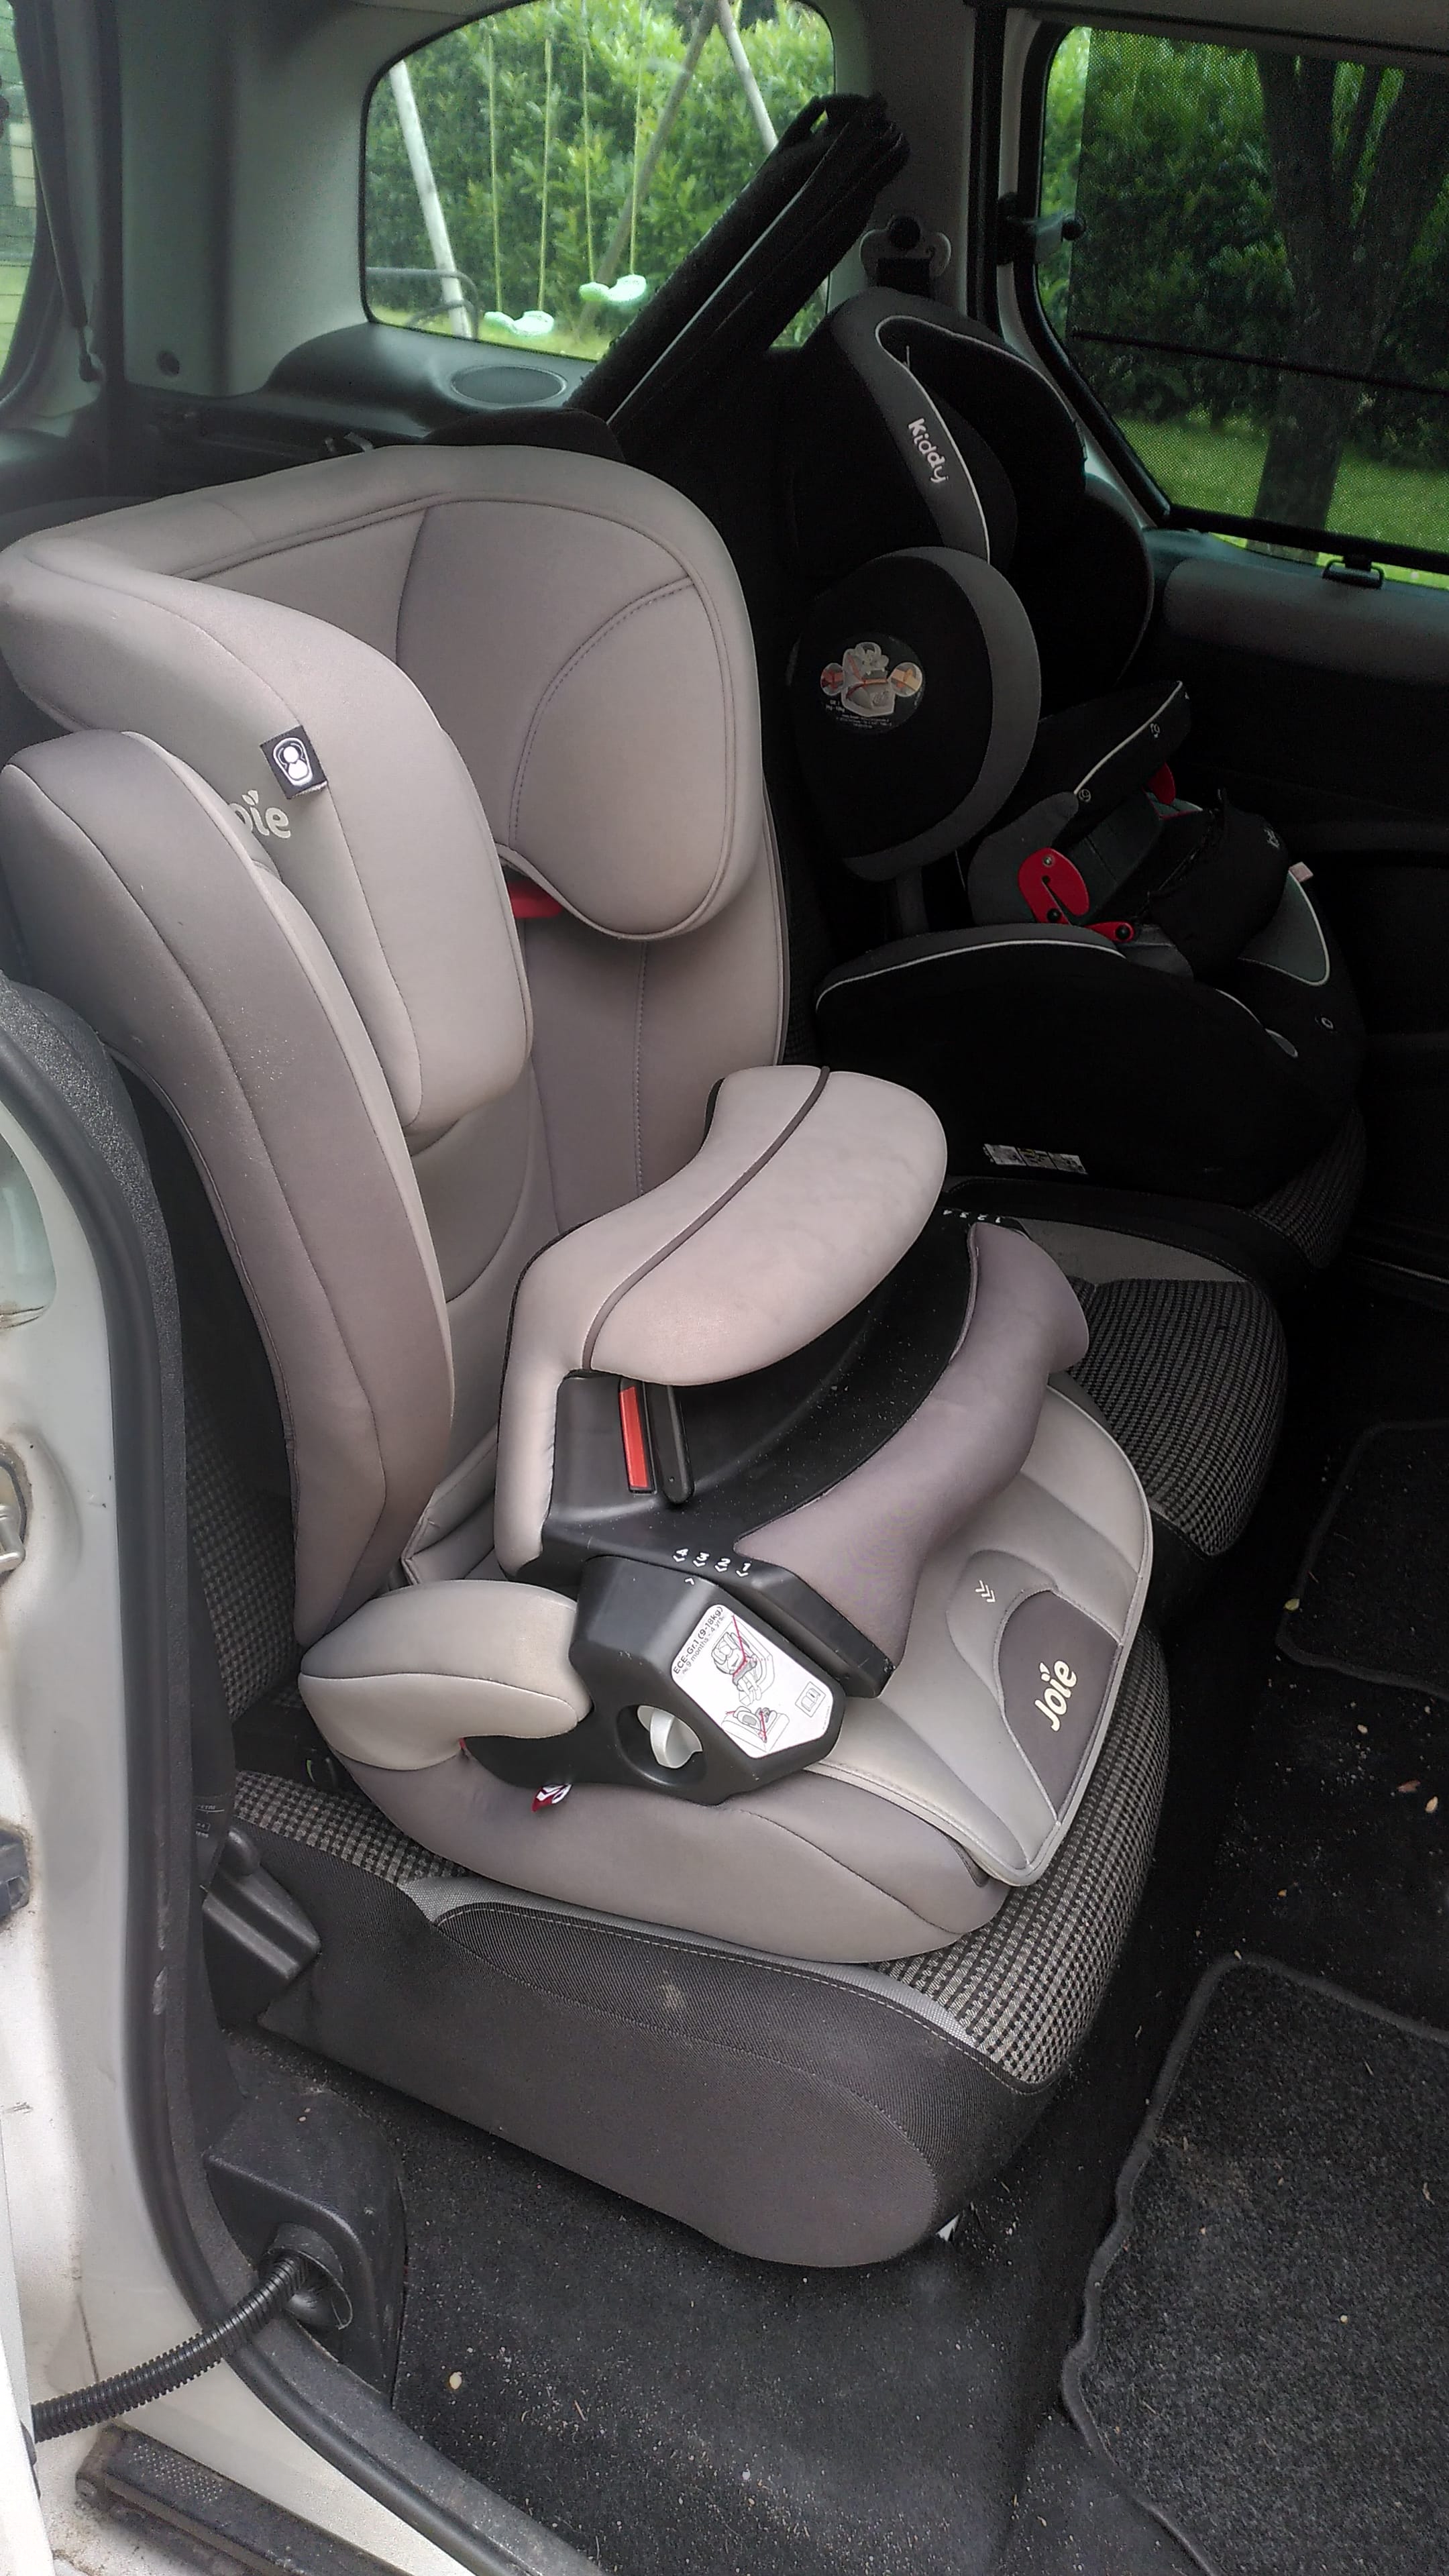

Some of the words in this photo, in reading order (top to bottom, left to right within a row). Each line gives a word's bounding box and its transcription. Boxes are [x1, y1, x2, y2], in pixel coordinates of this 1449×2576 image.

[908, 418, 947, 483] Kiddy
[228, 790, 291, 839] oie
[676, 1548, 688, 1556] 4
[696, 1552, 709, 1561] 3
[717, 1558, 731, 1566] 2
[743, 1563, 751, 1571] 1
[673, 1639, 699, 1674] ECE-Gr.1
[698, 1606, 723, 1639] (9-18kg)
[691, 1638, 709, 1662] months
[1034, 1660, 1077, 1731] Joie
